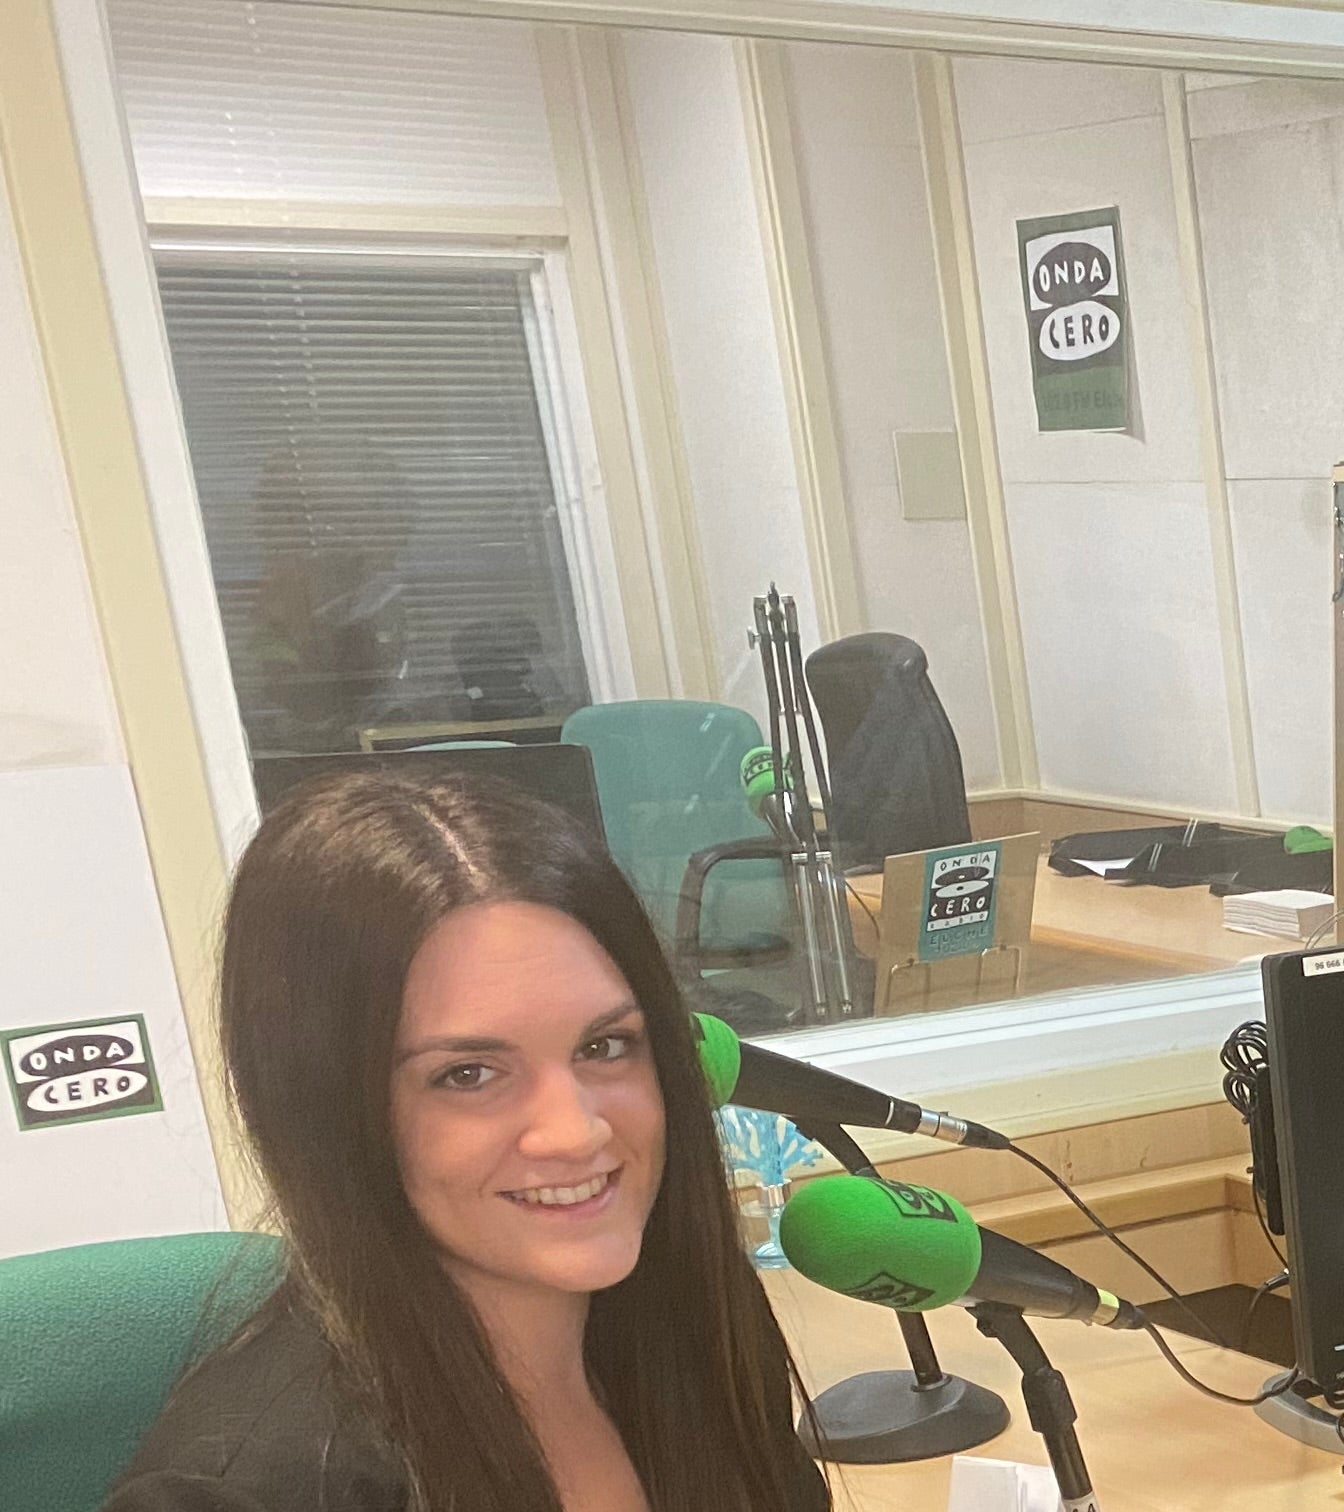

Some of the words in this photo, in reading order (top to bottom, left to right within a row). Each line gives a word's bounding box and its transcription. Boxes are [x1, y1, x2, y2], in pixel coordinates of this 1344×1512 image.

[1038, 256, 1105, 293] ONDA
[1049, 312, 1110, 350] CERO
[939, 853, 992, 872] ONDA
[930, 896, 986, 917] CERO
[29, 1042, 126, 1071] ONDA
[44, 1075, 131, 1105] CERO
